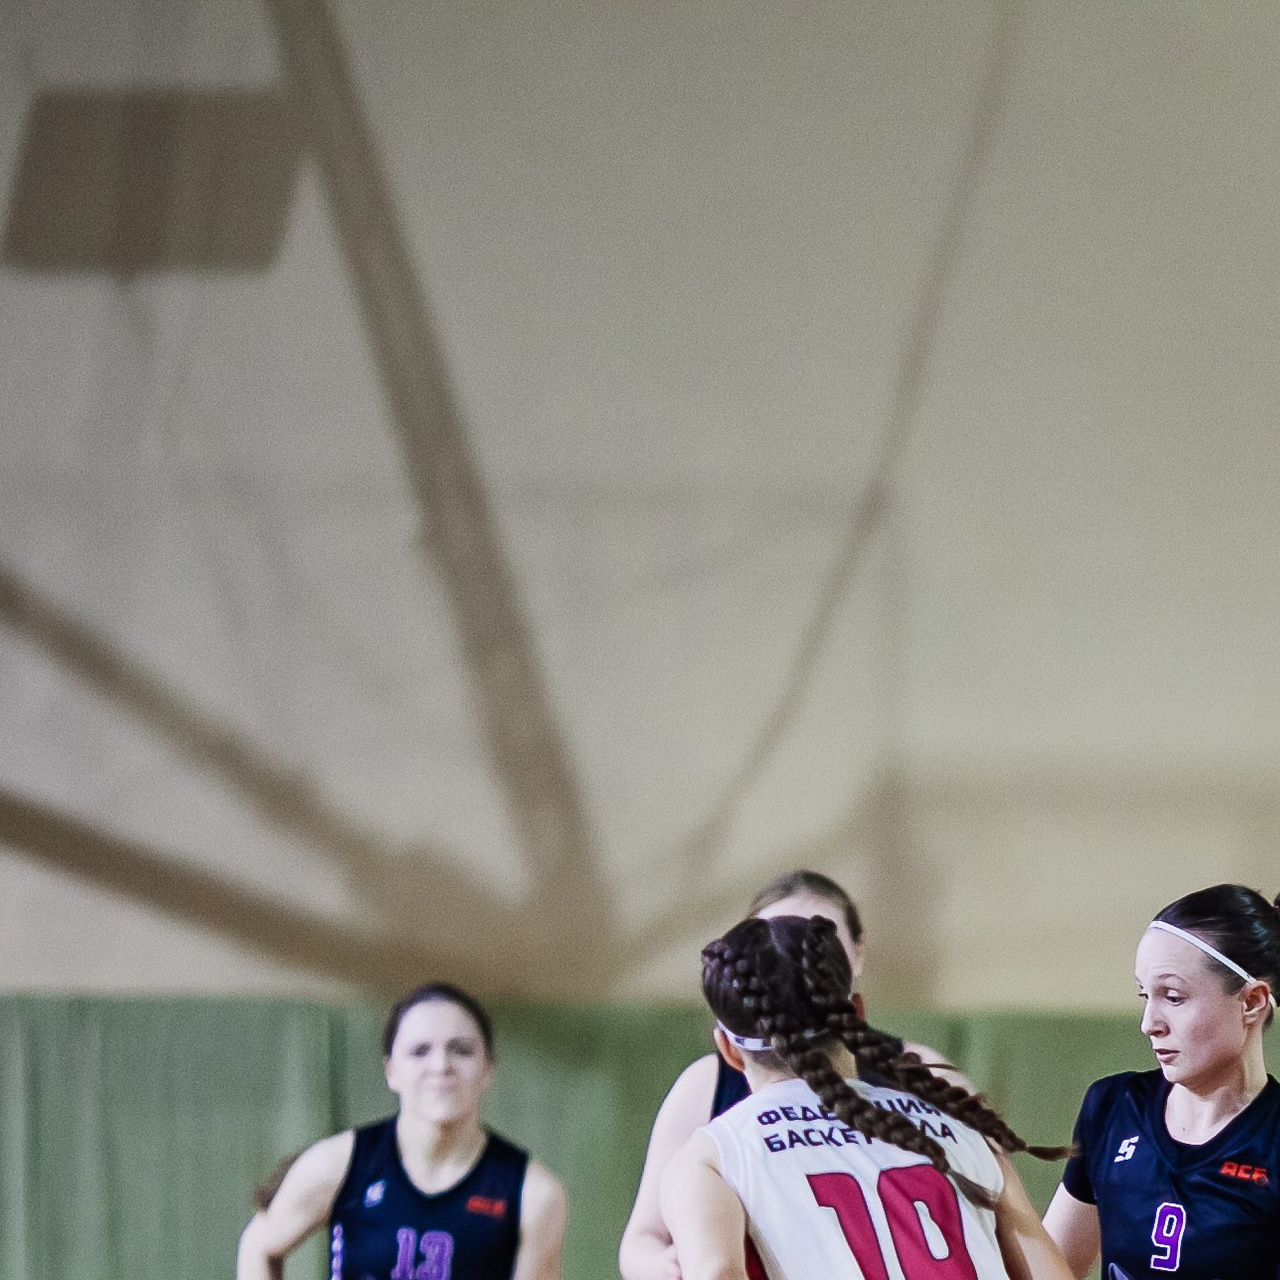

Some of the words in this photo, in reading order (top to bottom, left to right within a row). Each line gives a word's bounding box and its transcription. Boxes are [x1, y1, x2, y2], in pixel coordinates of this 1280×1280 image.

[756, 1098, 942, 1126] ФЕДЕЦИЯ
[763, 1119, 958, 1153] БАСКЕЛА
[1150, 1201, 1187, 1272] 9
